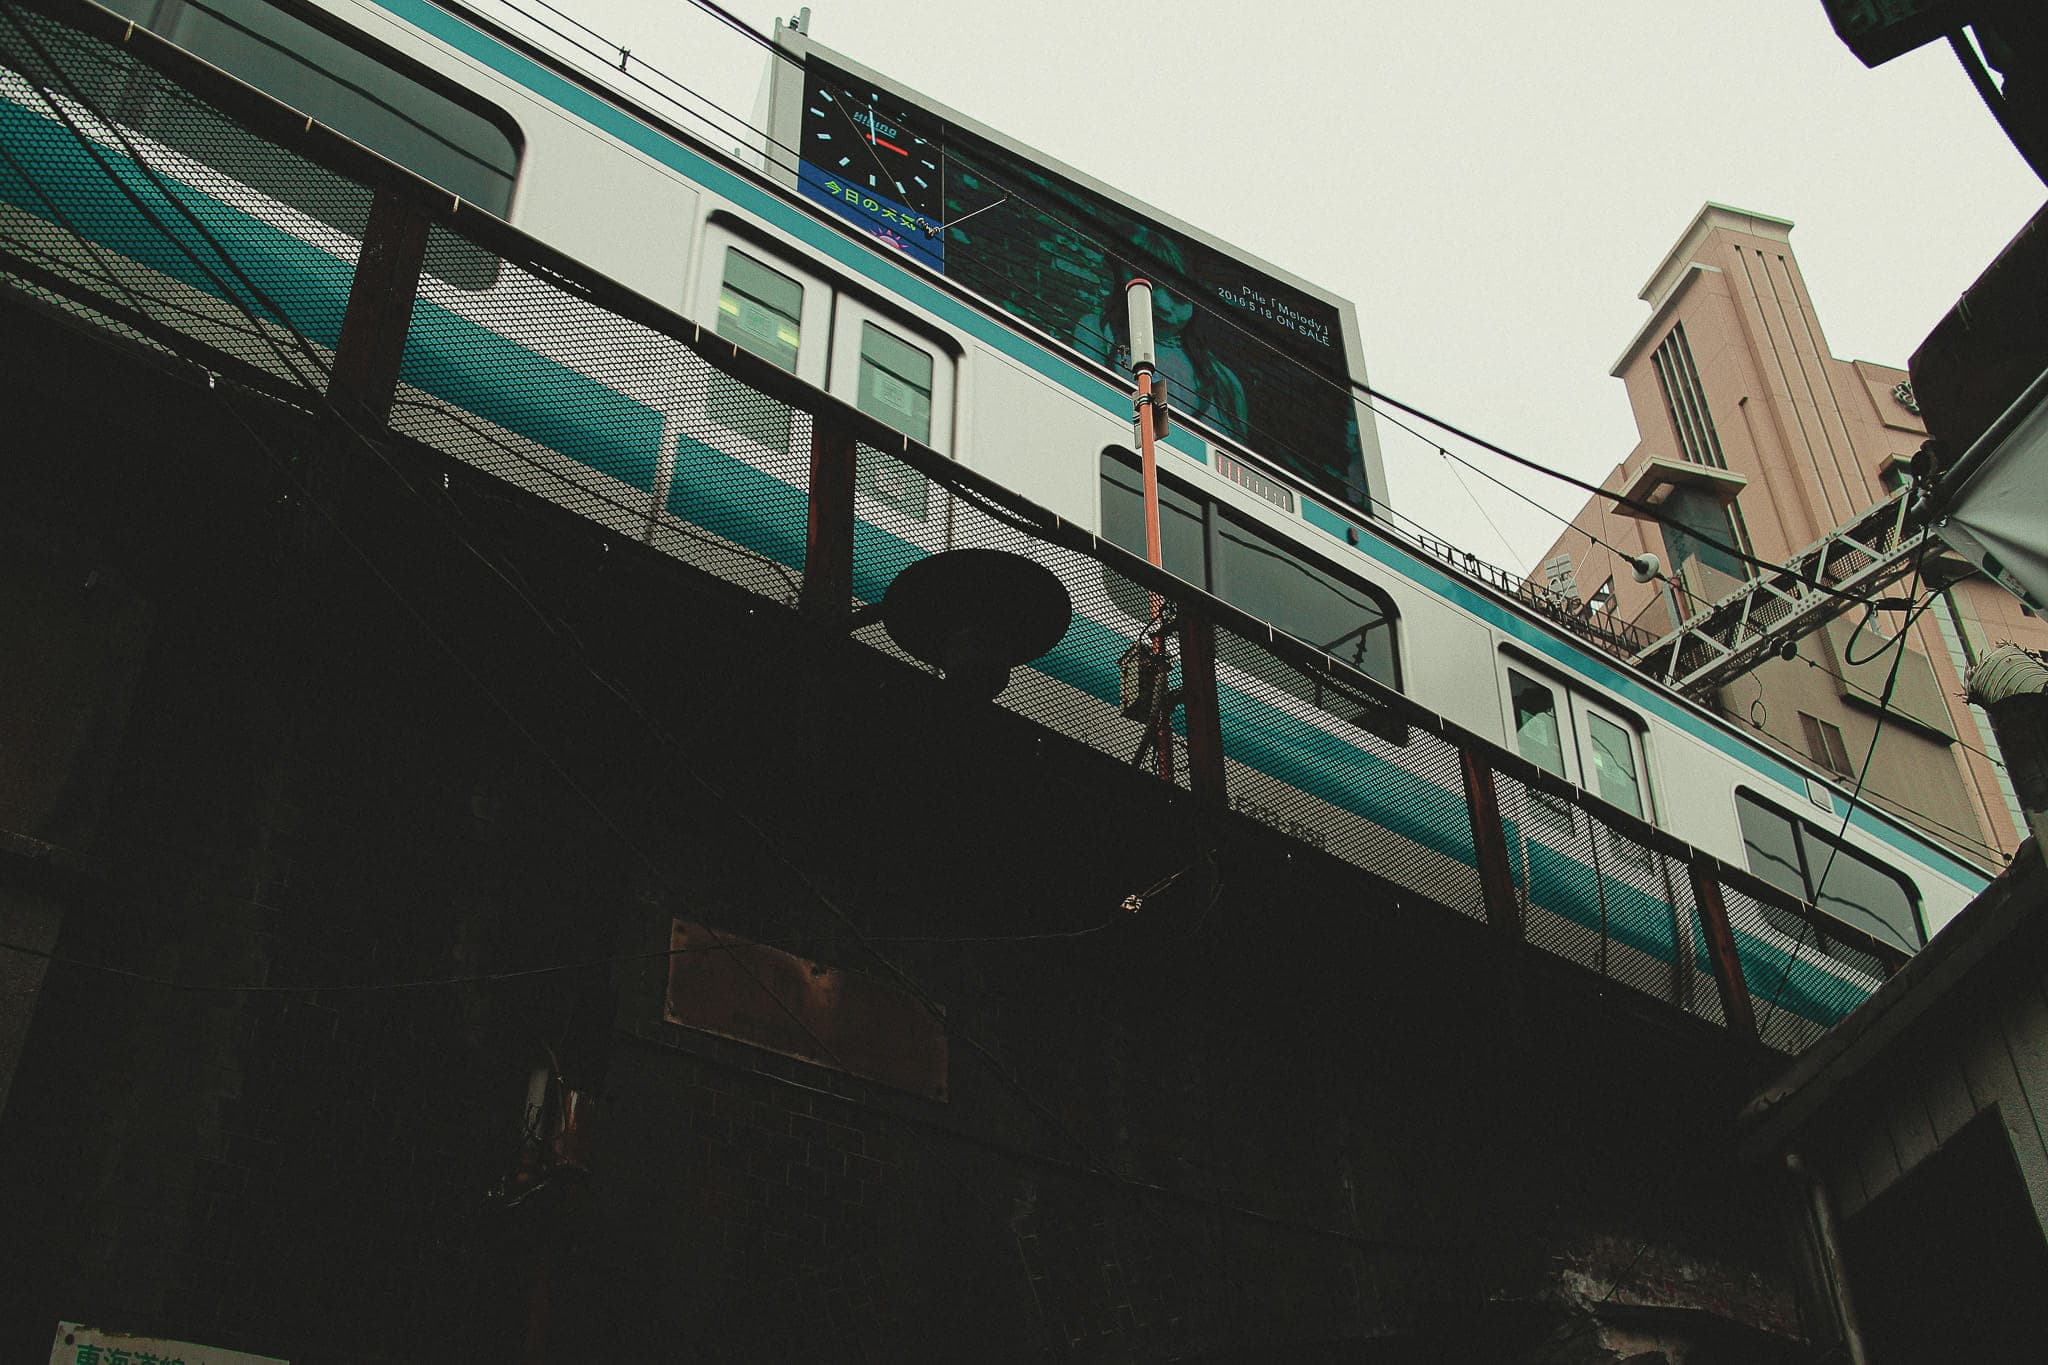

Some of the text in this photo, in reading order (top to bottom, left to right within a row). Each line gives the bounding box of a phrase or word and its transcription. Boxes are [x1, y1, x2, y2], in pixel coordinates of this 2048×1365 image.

[824, 180, 917, 231] 今日の天気
[1242, 286, 1266, 305] Pile
[1276, 315, 1295, 330] ON
[1299, 325, 1330, 347] SALE
[76, 1343, 185, 1365] 東海
